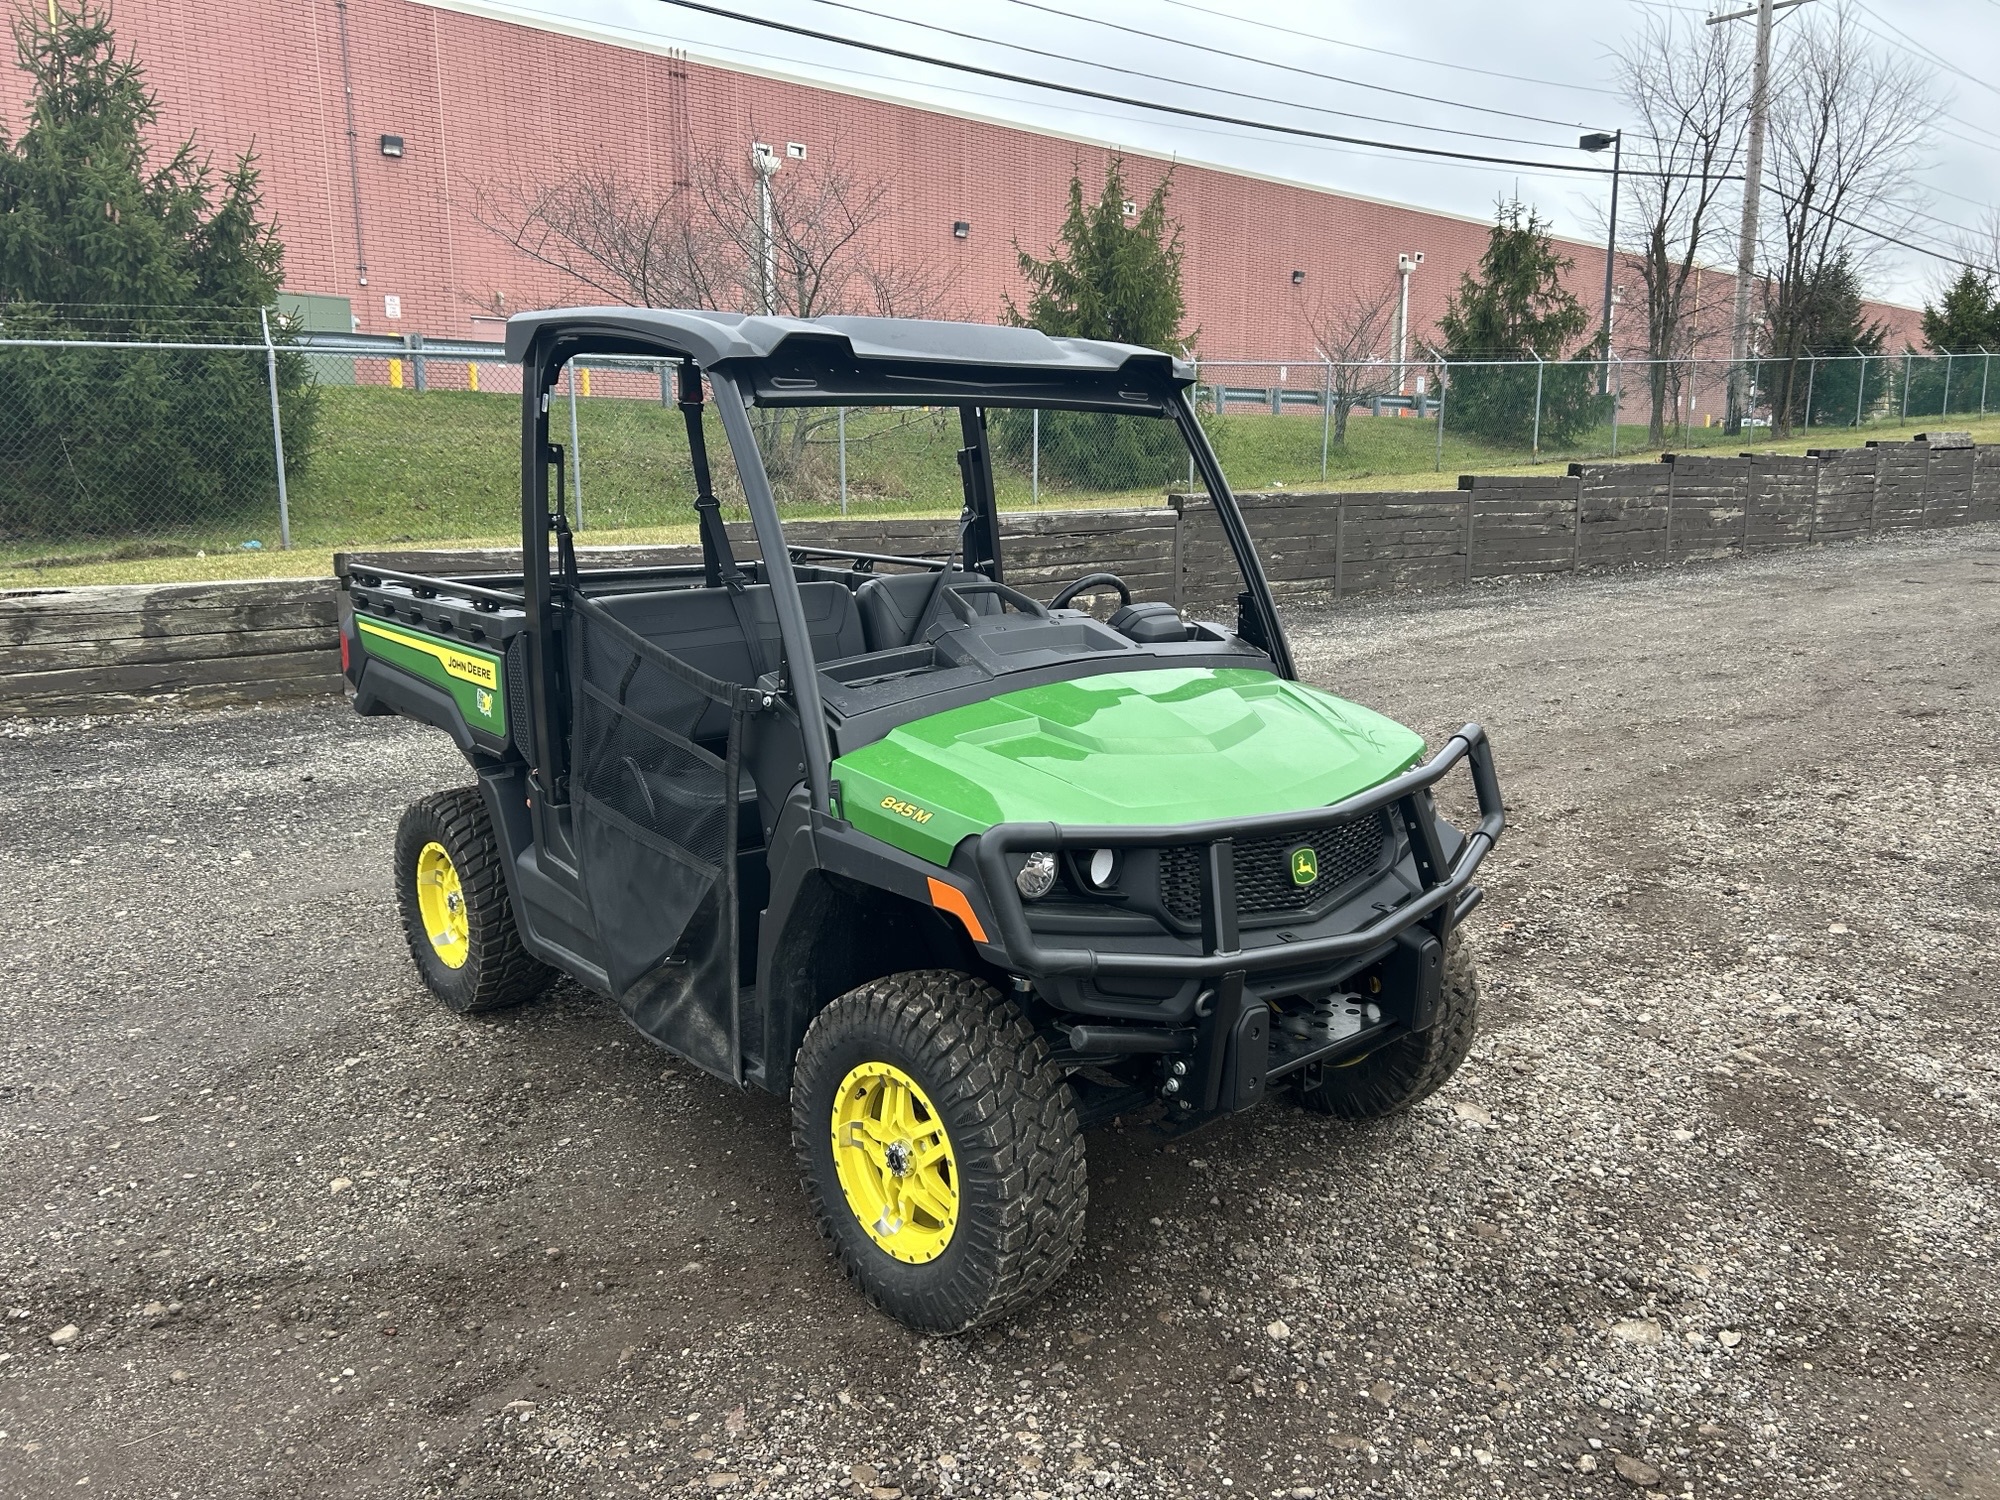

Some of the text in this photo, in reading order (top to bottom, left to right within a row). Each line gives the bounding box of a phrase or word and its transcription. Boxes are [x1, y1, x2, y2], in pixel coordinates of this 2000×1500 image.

[448, 656, 491, 680] JOHN DEERE
[880, 795, 935, 825] 845M
